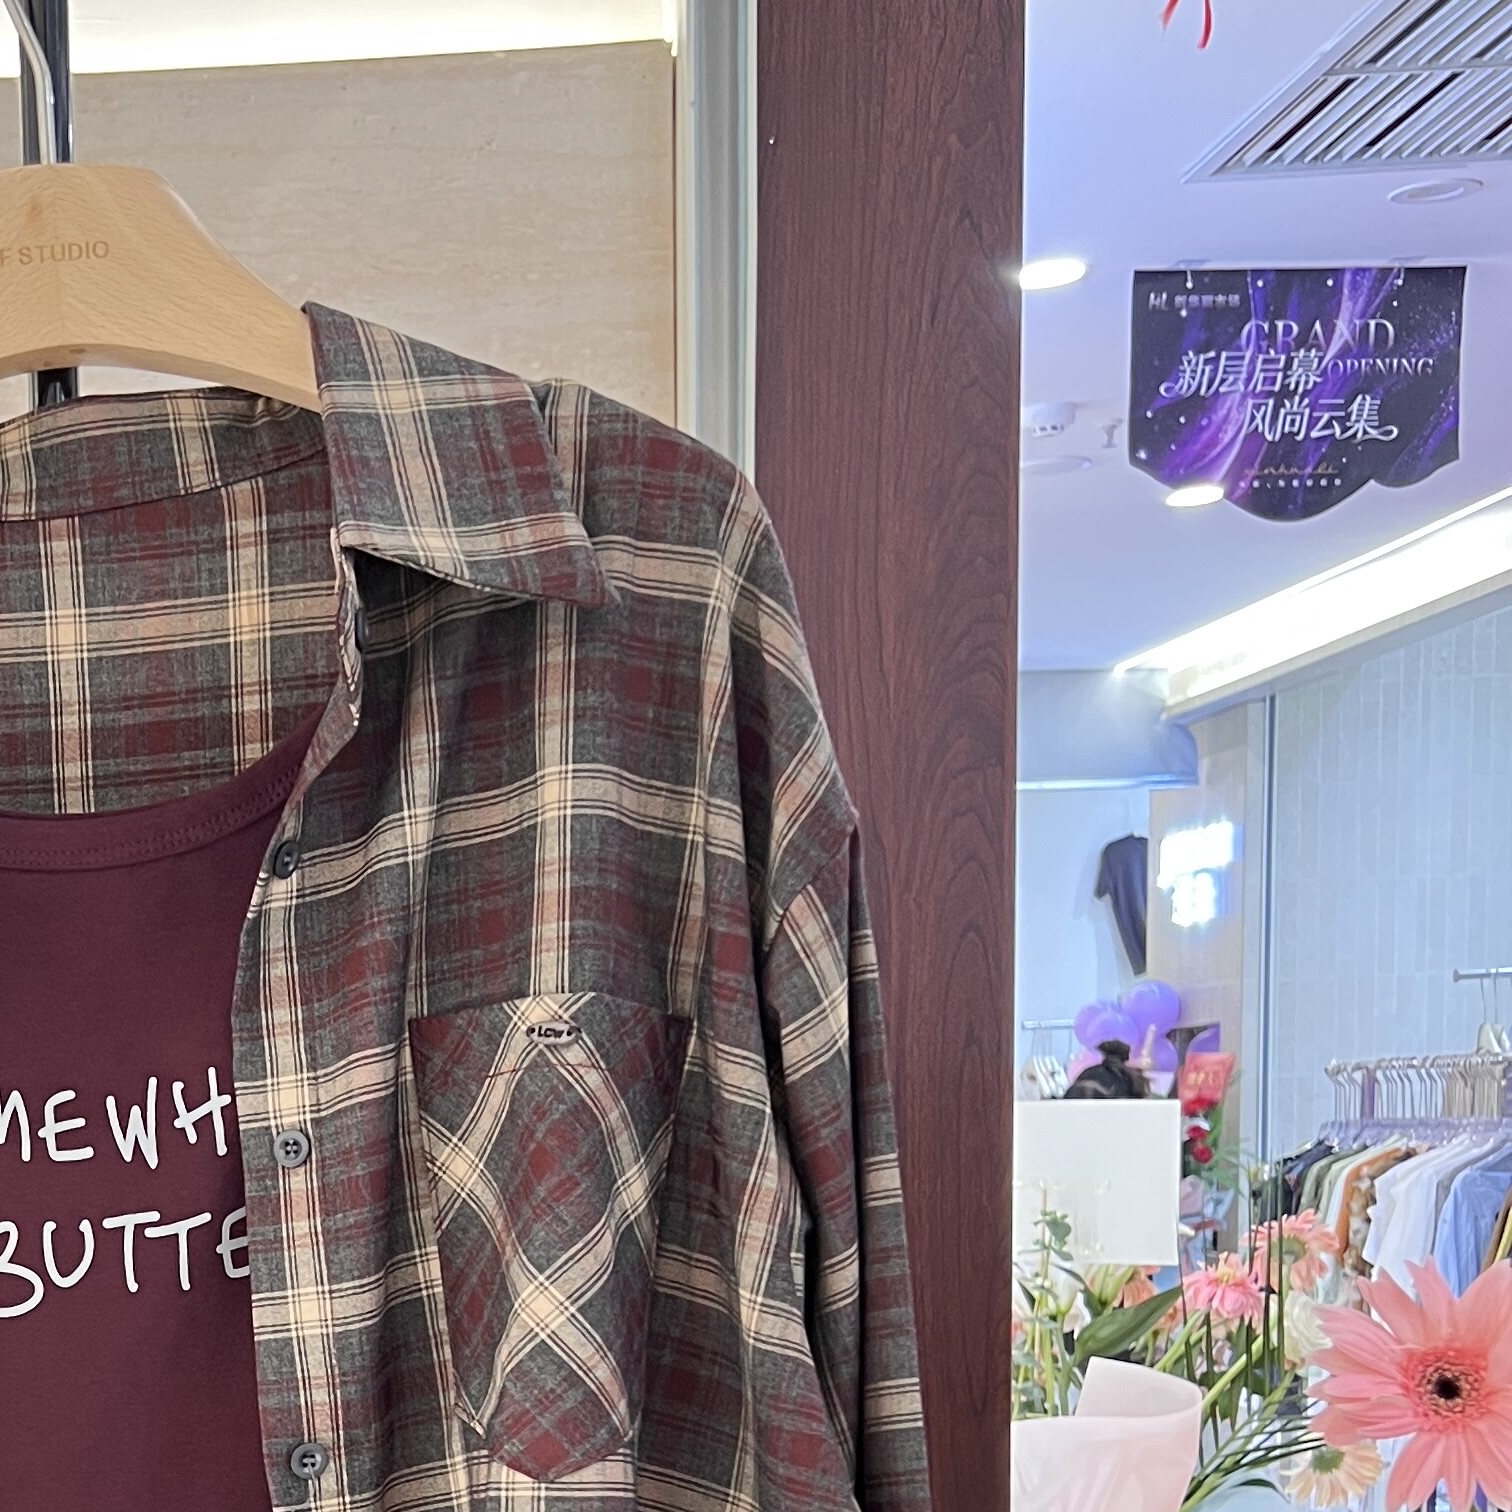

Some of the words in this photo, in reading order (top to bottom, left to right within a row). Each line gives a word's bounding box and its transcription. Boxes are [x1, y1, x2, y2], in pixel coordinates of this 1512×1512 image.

[18, 240, 109, 266] STUDIO
[1240, 317, 1396, 354] GRAND
[1158, 348, 1325, 399] 新层启幕
[1326, 357, 1435, 377] OPENING
[1245, 393, 1400, 442] 风尚云集
